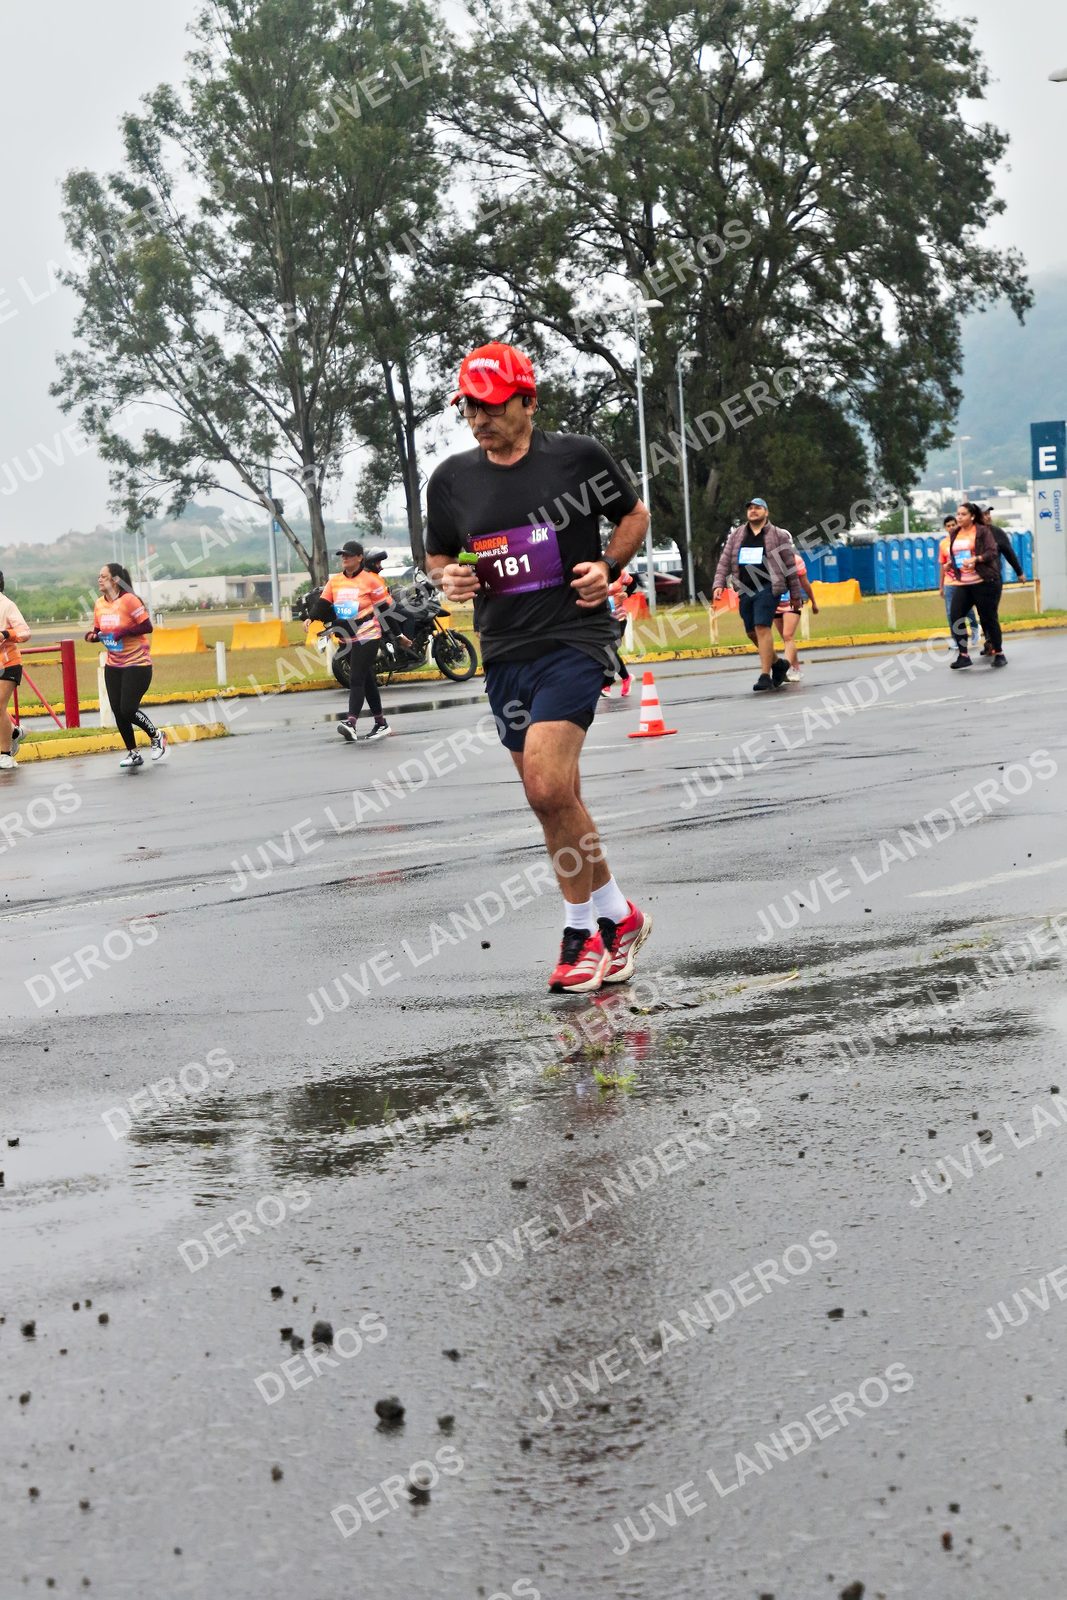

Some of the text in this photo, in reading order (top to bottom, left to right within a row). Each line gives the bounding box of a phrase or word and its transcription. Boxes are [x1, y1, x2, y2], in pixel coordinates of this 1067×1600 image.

[1039, 446, 1058, 472] E
[1054, 490, 1062, 532] General
[473, 536, 508, 551] CARRERA
[493, 554, 531, 578] 181
